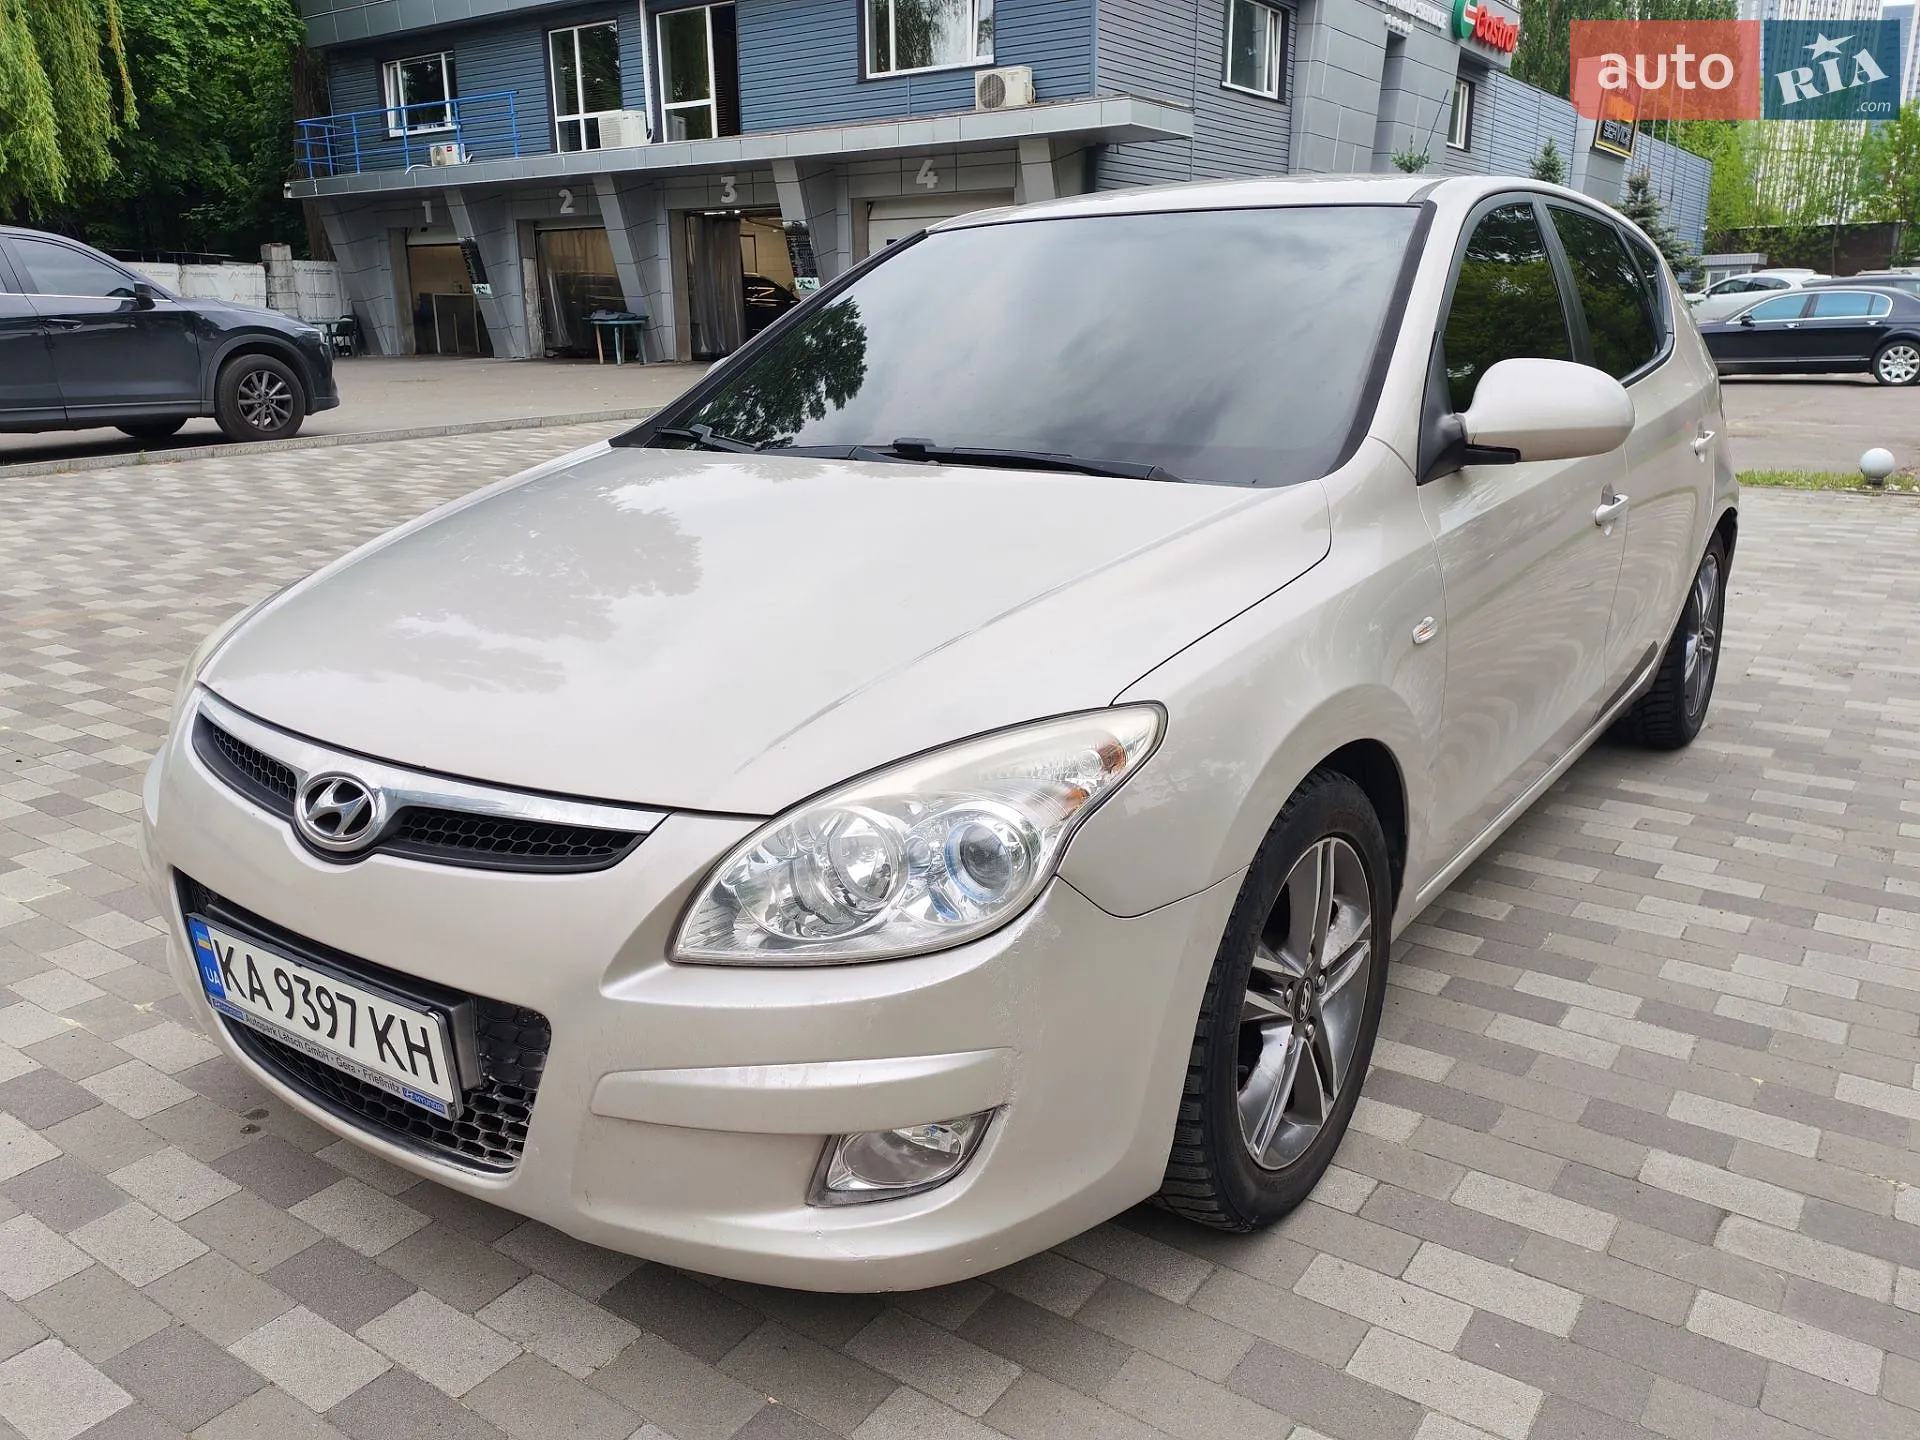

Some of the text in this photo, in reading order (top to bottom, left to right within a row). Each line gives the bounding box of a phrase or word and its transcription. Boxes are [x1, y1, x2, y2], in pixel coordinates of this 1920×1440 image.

[1476, 4, 1518, 53] Castrol
[916, 159, 938, 189] 4
[558, 189, 576, 214] 2
[720, 176, 738, 204] 3
[422, 200, 432, 223] 1
[205, 966, 221, 986] UA
[213, 939, 439, 1085] KA 9397 KH
[245, 1013, 277, 1037] Autopark
[305, 1041, 330, 1061] GmbH
[336, 1056, 356, 1073] Gera
